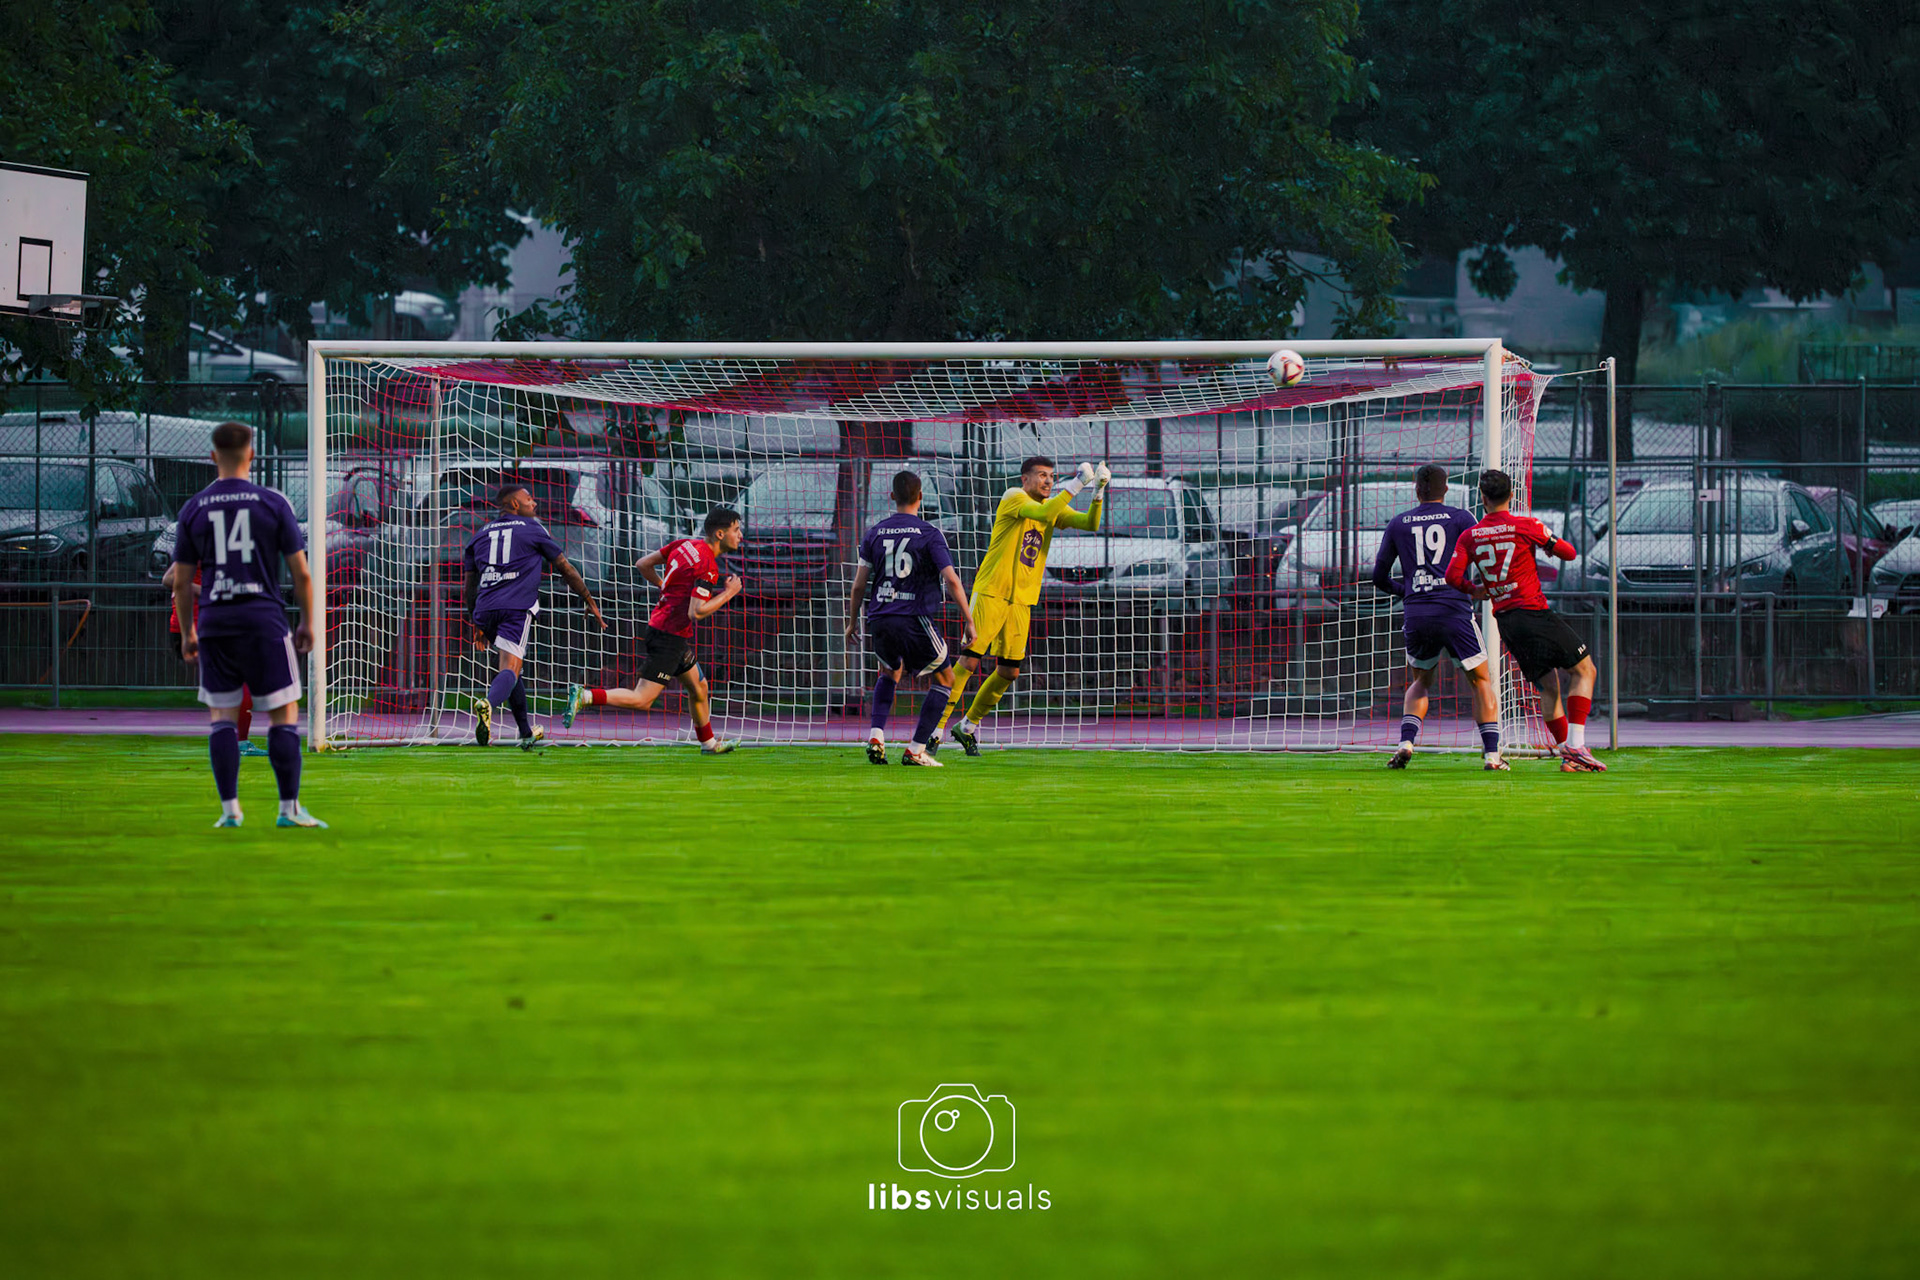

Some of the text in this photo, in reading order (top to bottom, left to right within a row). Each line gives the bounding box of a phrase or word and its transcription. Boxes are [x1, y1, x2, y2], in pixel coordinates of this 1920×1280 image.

[209, 493, 260, 503] HONDA
[1411, 513, 1451, 522] HONDA
[207, 508, 255, 565] 14
[488, 528, 513, 565] 11
[886, 527, 922, 535] HONDA
[1411, 523, 1446, 566] 19
[882, 537, 913, 579] 16
[1475, 541, 1516, 582] 27
